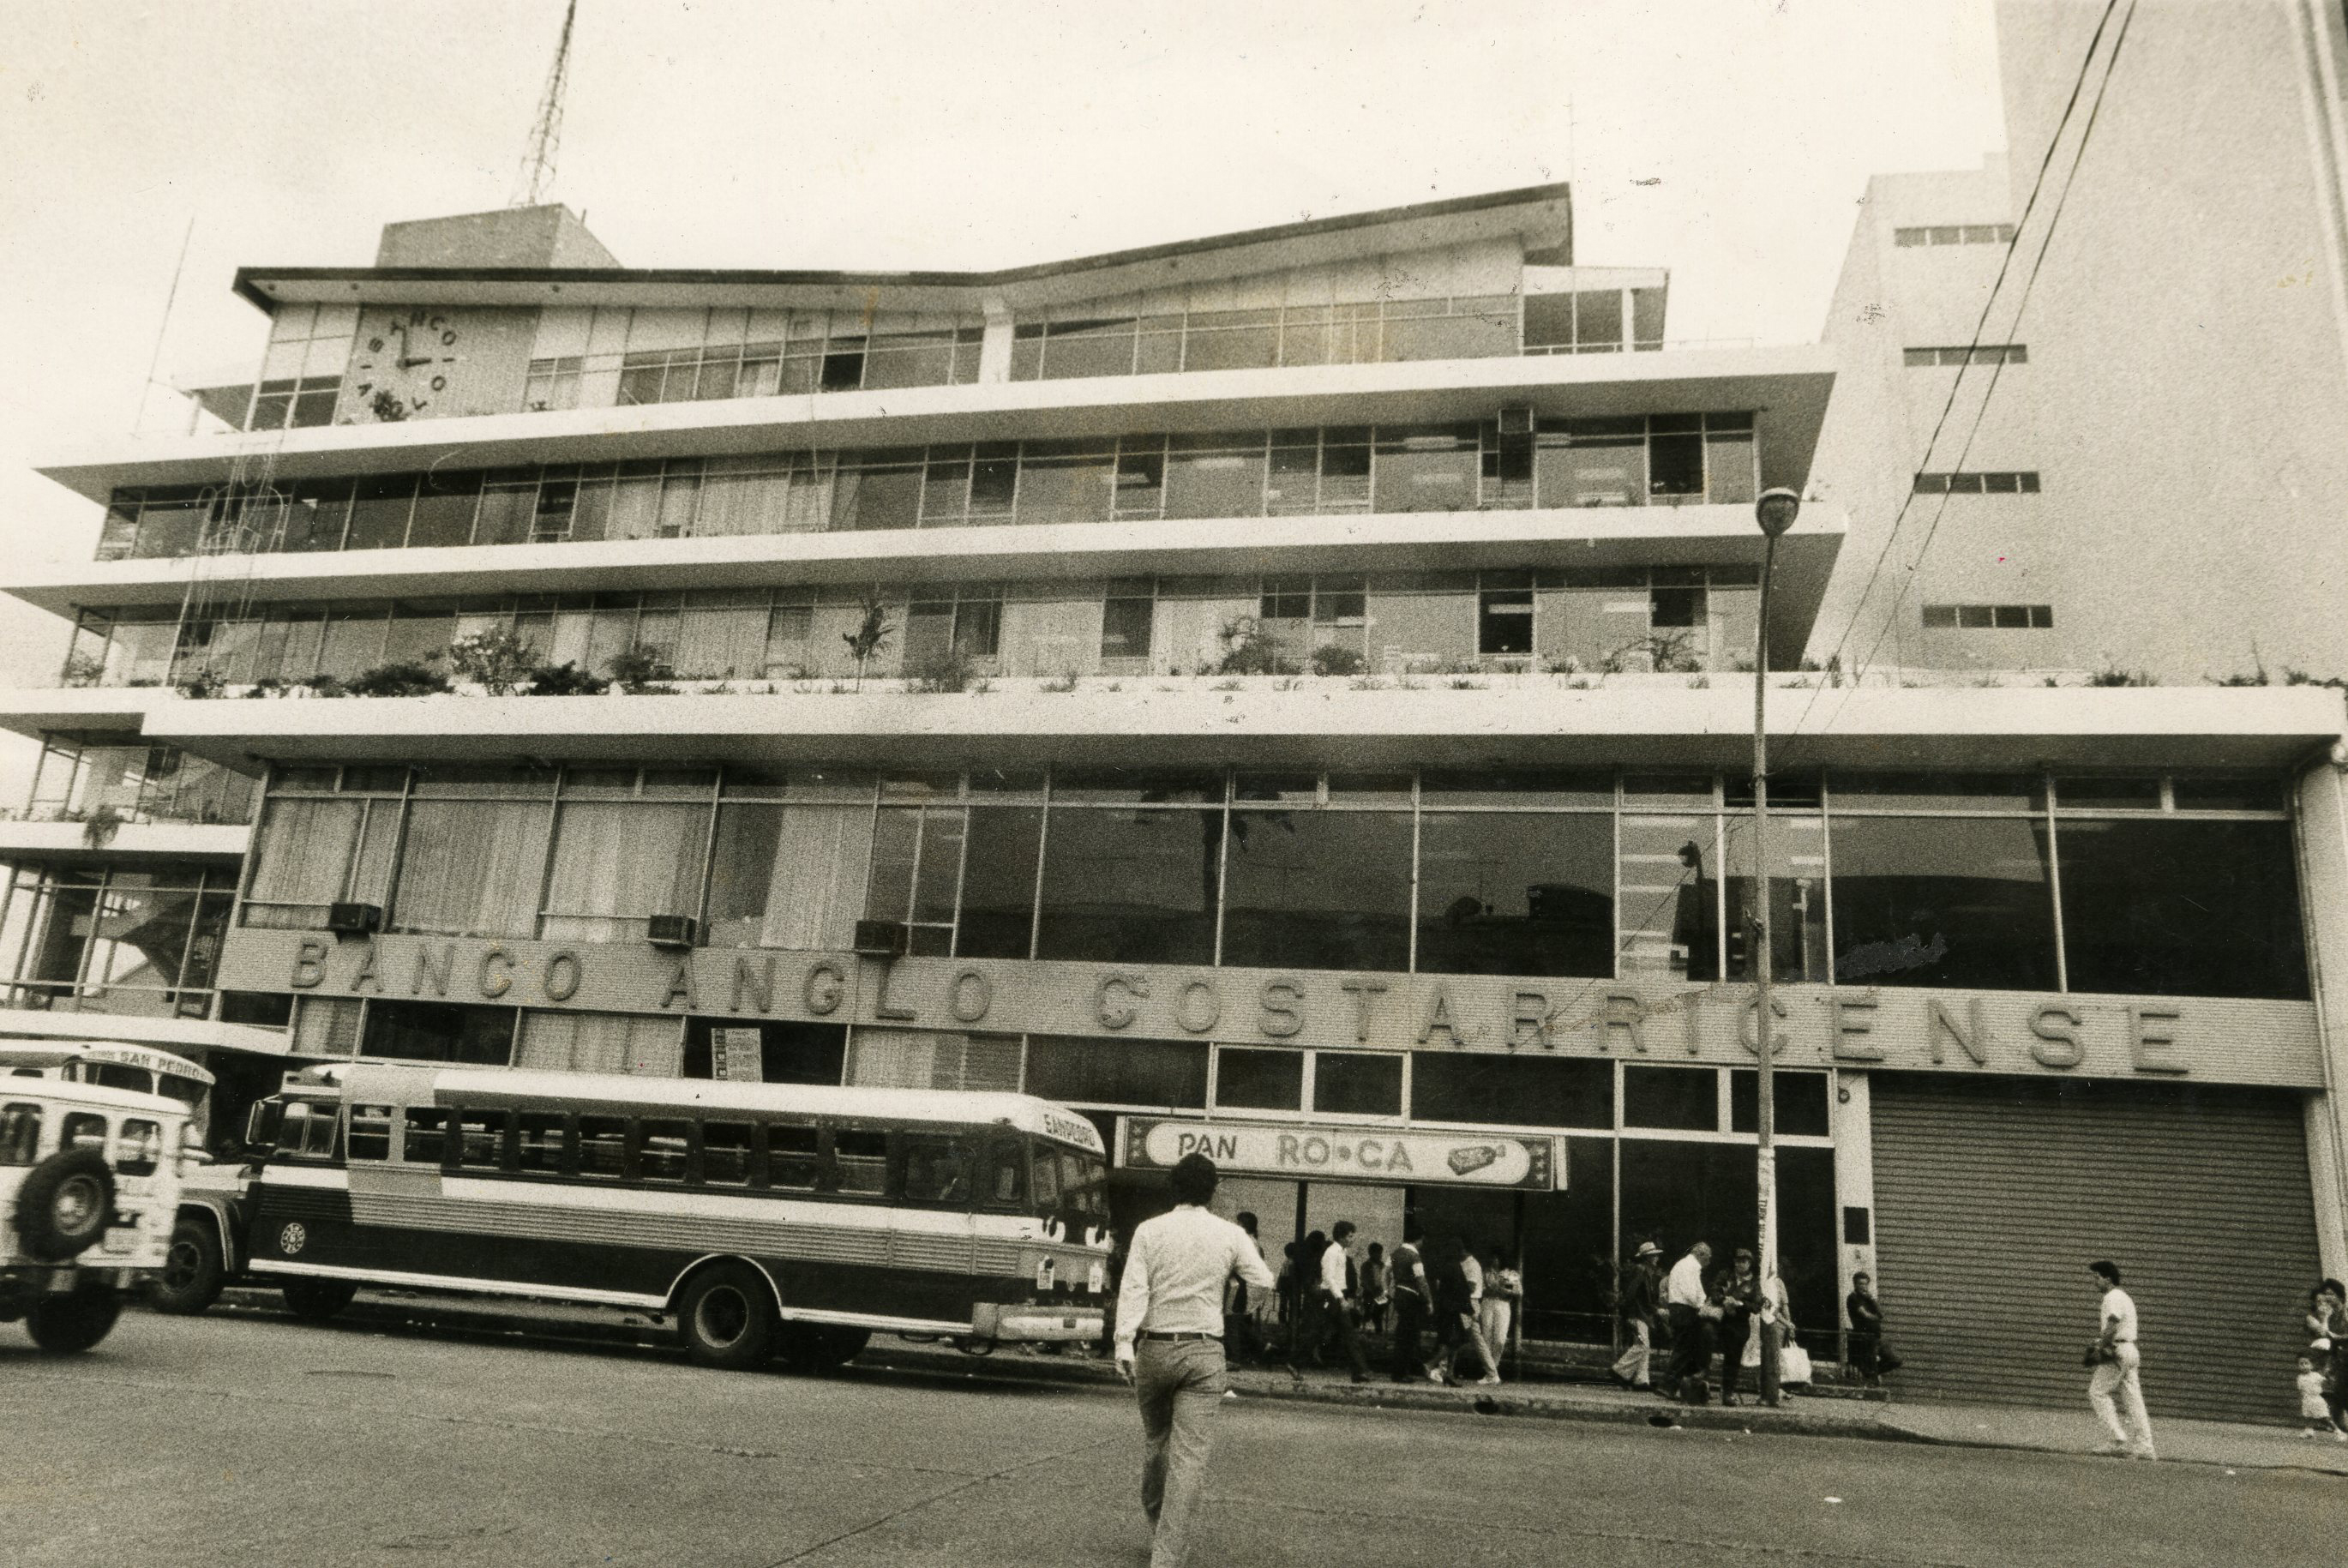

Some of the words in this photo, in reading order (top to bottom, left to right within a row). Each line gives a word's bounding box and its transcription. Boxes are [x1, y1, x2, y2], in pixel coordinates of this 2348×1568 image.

[291, 936, 583, 1001] BANCO
[660, 952, 993, 1022] ANGLO
[1094, 969, 2189, 1075] COSTARRICENSE
[120, 1049, 150, 1066] SAN
[159, 1057, 201, 1078] PEDRO
[1178, 1132, 1236, 1159] PAN
